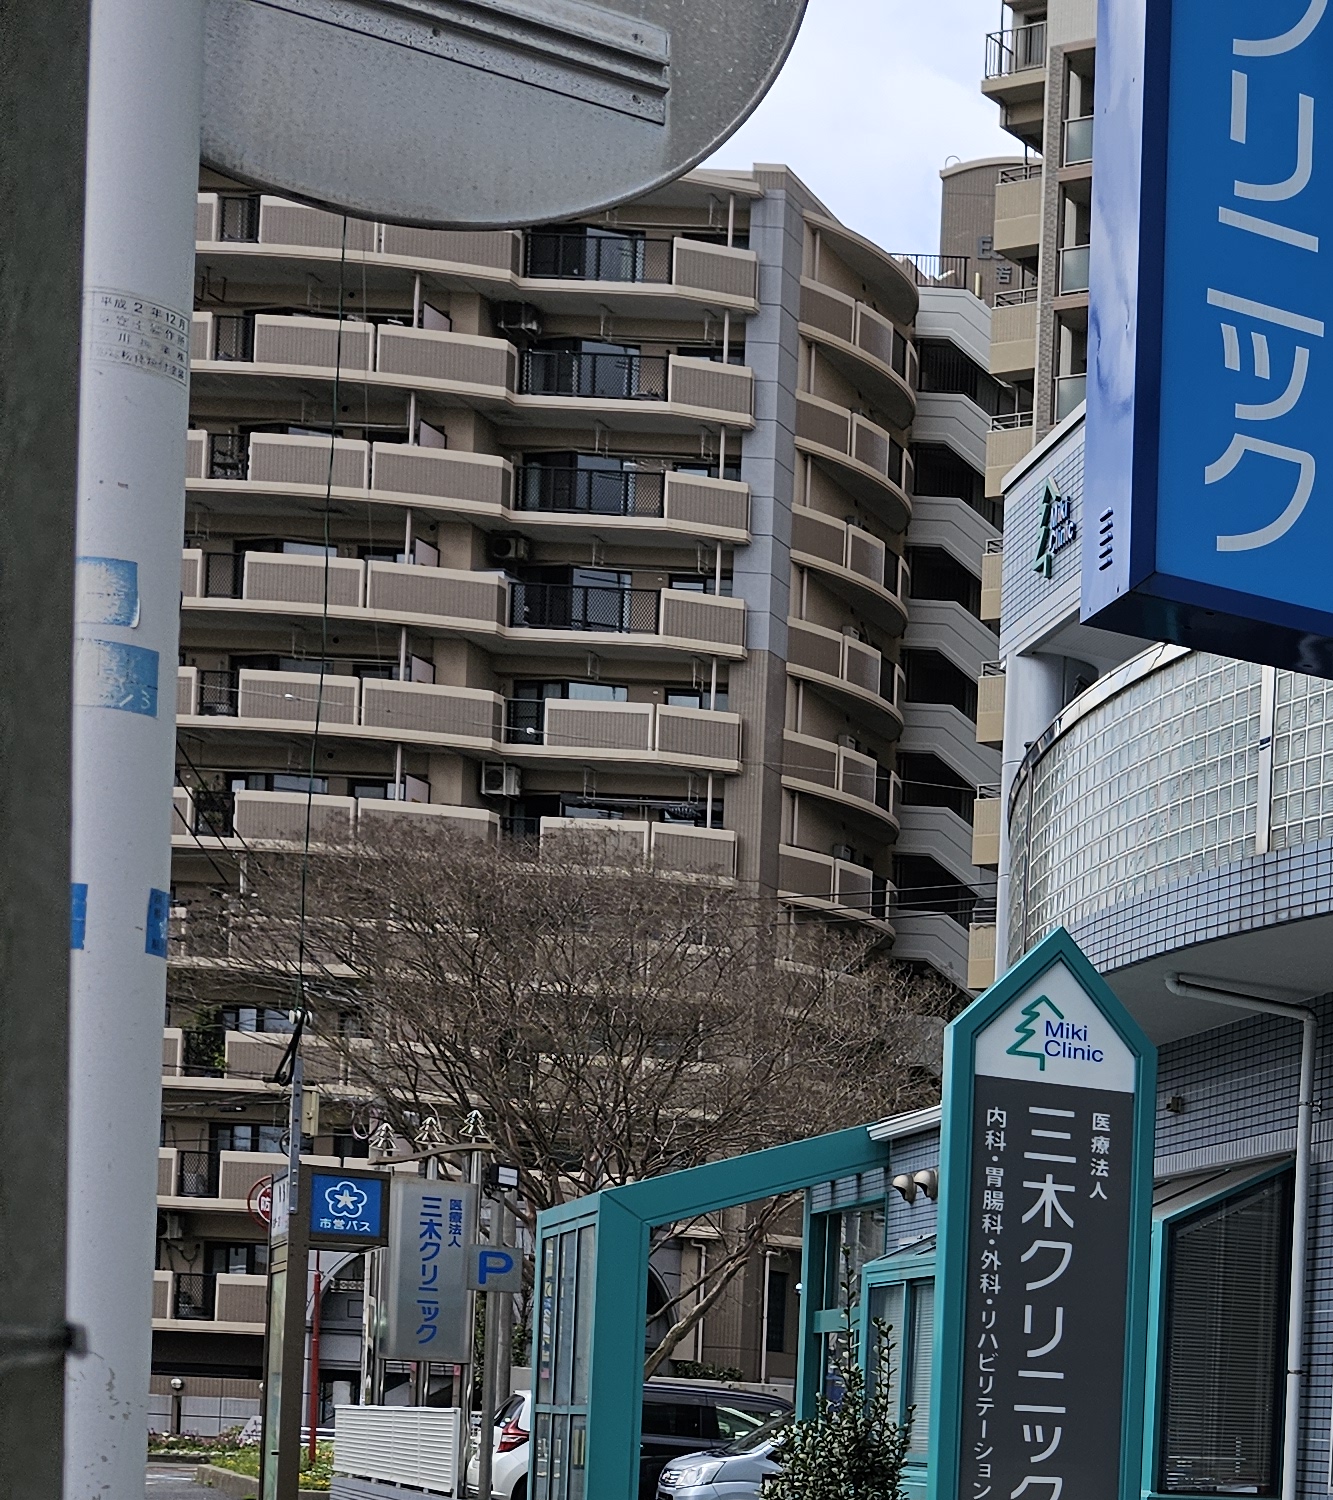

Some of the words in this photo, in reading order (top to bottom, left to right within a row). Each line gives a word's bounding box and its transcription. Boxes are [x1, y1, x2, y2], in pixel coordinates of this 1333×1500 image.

[1044, 1019, 1088, 1042] Miki
[1043, 1039, 1104, 1064] Clinic
[1088, 1112, 1111, 1201] 医療法人
[319, 1217, 371, 1232] 市営バス
[448, 1198, 463, 1248] 医療法人
[416, 1196, 443, 1345] 三木クリニック
[478, 1250, 514, 1285] P
